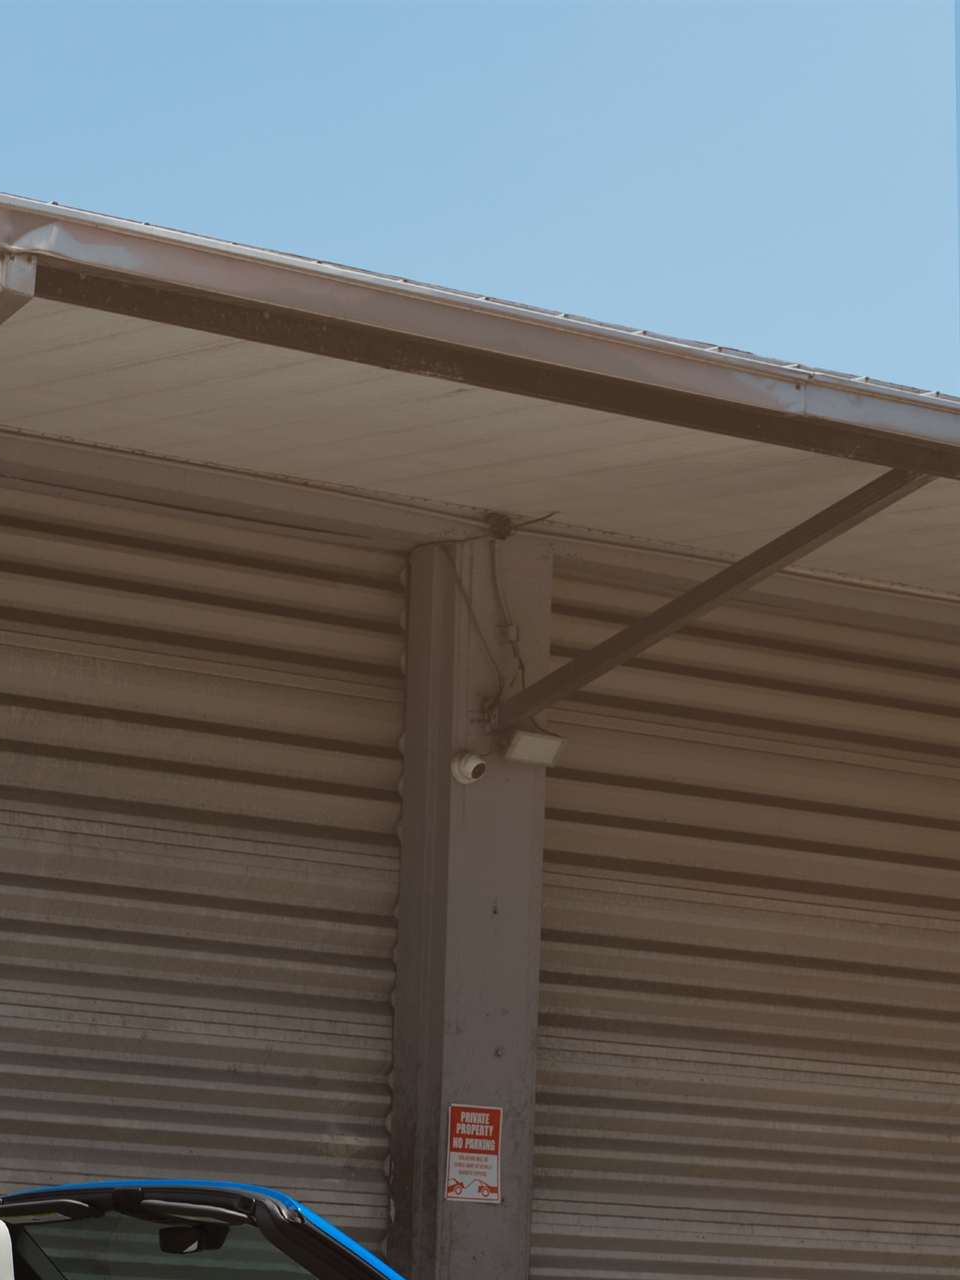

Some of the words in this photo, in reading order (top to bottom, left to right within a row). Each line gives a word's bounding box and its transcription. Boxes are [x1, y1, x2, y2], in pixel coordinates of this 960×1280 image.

[460, 1111, 490, 1124] PRIVATE
[456, 1123, 494, 1136] PROPERTY
[452, 1137, 463, 1149] NO
[465, 1138, 495, 1151] PARKING
